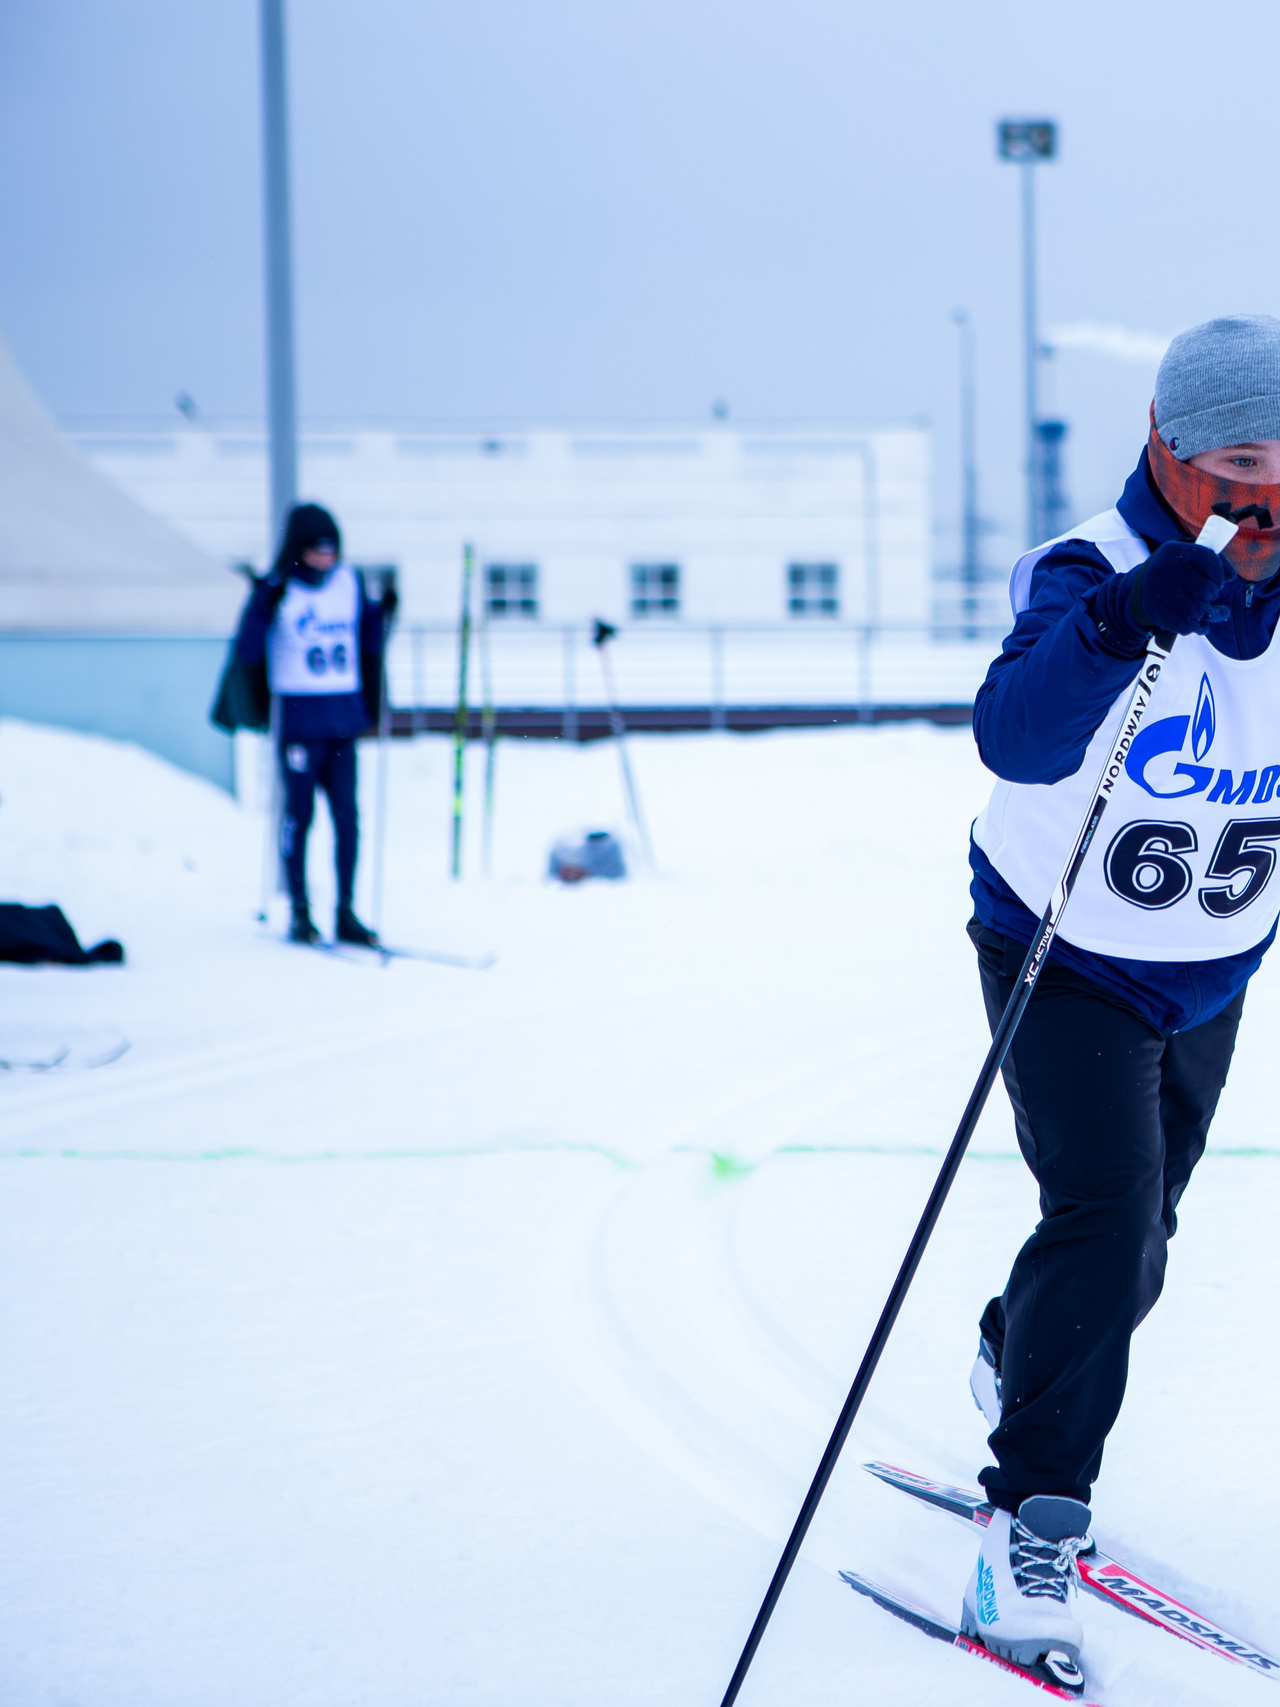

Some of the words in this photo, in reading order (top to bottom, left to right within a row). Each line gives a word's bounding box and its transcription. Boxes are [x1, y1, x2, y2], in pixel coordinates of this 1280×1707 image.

[307, 645, 347, 676] 66
[1103, 695, 1147, 794] NORDWAY
[1024, 961, 1040, 987] XC
[1034, 924, 1053, 962] ACTIVE
[983, 1564, 1000, 1627] NORDWAY
